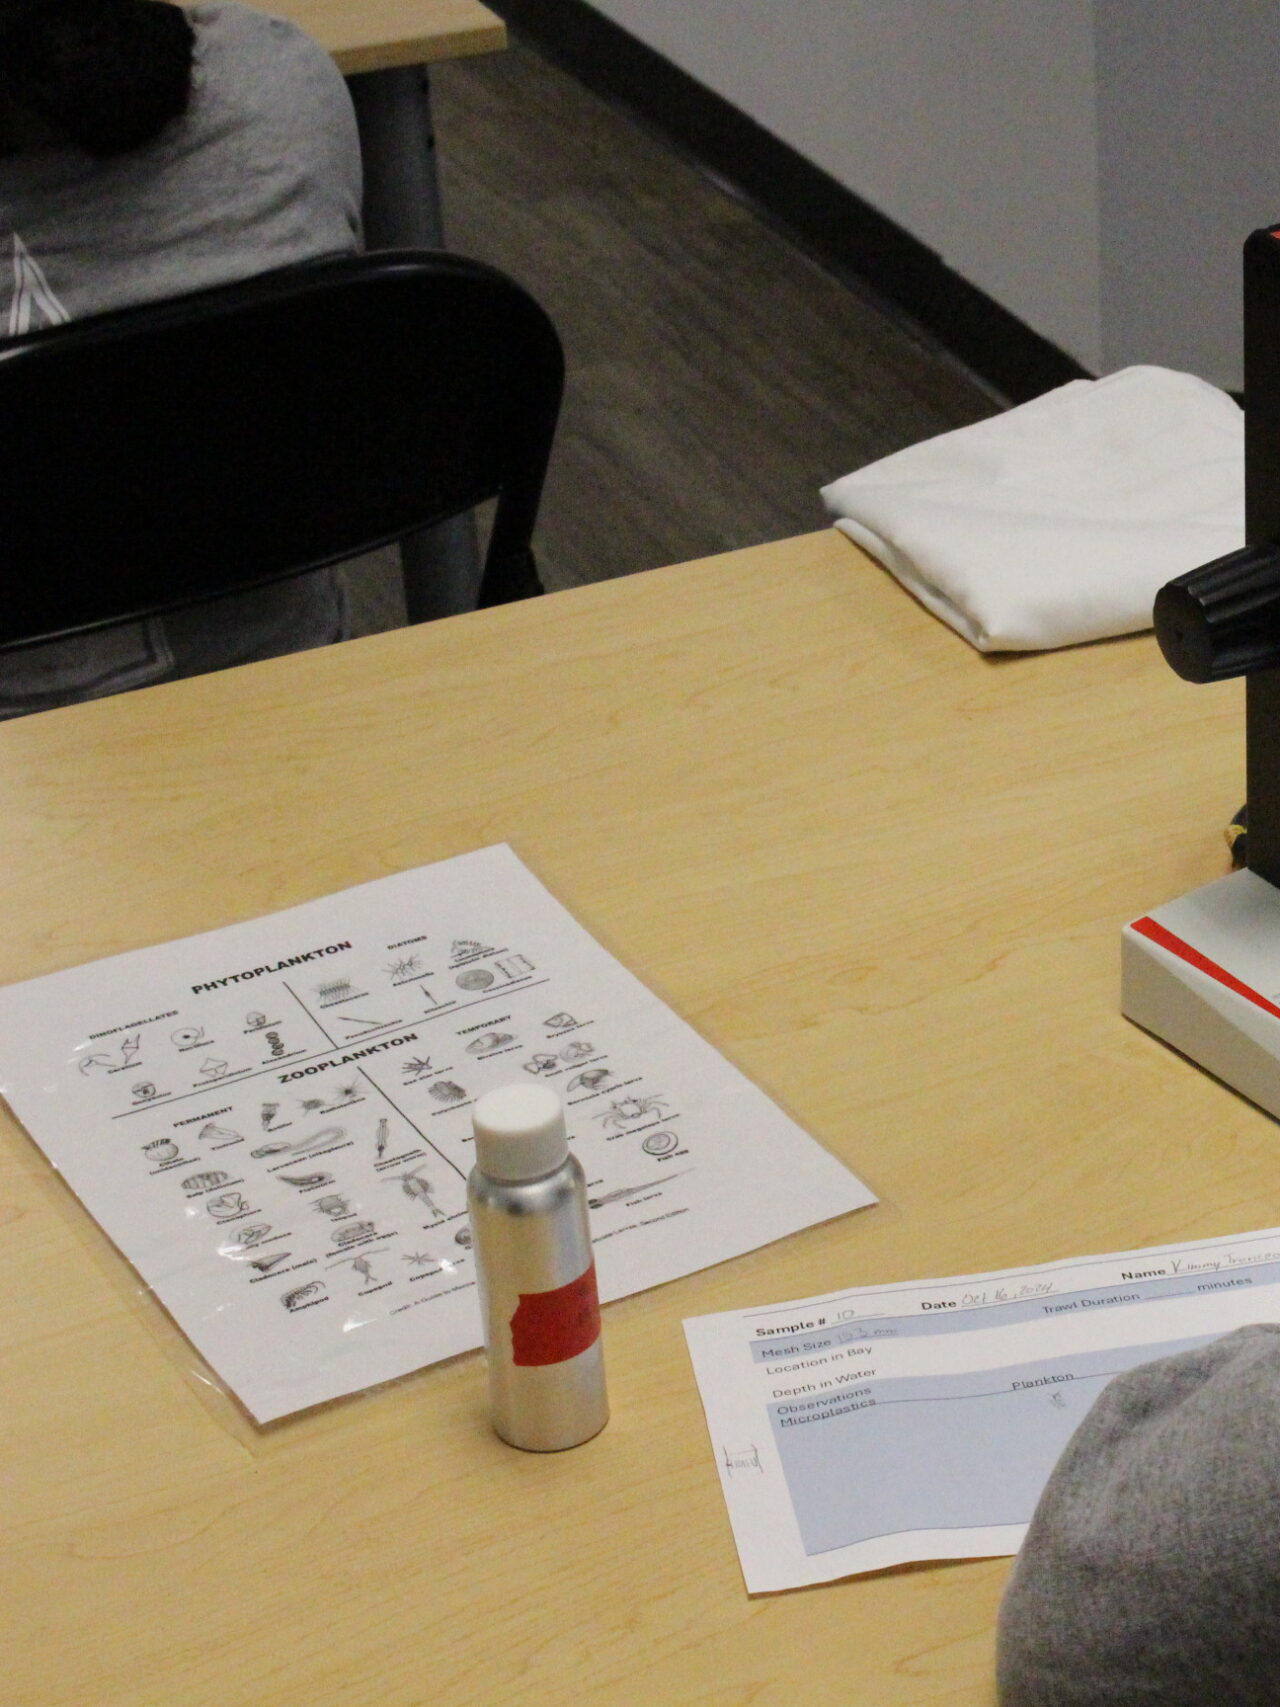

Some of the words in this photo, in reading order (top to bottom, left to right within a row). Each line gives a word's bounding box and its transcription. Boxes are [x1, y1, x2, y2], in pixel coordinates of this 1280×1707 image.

[387, 935, 427, 950] DIATOMS
[191, 940, 352, 994] PHYTOPLANKTON
[89, 1010, 179, 1039] DINOFLAGELLATES
[456, 1015, 512, 1036] TEMPORARY
[278, 1033, 418, 1084] ZOOPLANKTON
[173, 1106, 233, 1127] PERMANENT
[657, 1153, 673, 1163] Fish
[1121, 1267, 1166, 1281] Name
[1197, 1277, 1253, 1292] minutes
[289, 1296, 329, 1313] Amphipod
[921, 1300, 957, 1310] Date
[962, 1292, 987, 1305] Oct
[1043, 1302, 1078, 1314] Trawl
[1081, 1292, 1140, 1308] Duration
[755, 1321, 815, 1337] Sample
[818, 1317, 826, 1325] #
[762, 1346, 799, 1358] Mesh
[803, 1339, 832, 1350] Size
[766, 1358, 828, 1375] Location
[832, 1353, 844, 1361] in
[847, 1346, 872, 1357] Bay
[773, 1384, 816, 1398] Depth
[820, 1379, 833, 1388] in
[835, 1368, 877, 1384] Water
[1011, 1373, 1074, 1391] Plankton
[777, 1387, 872, 1415] Observations
[780, 1399, 876, 1428] Microplastics
